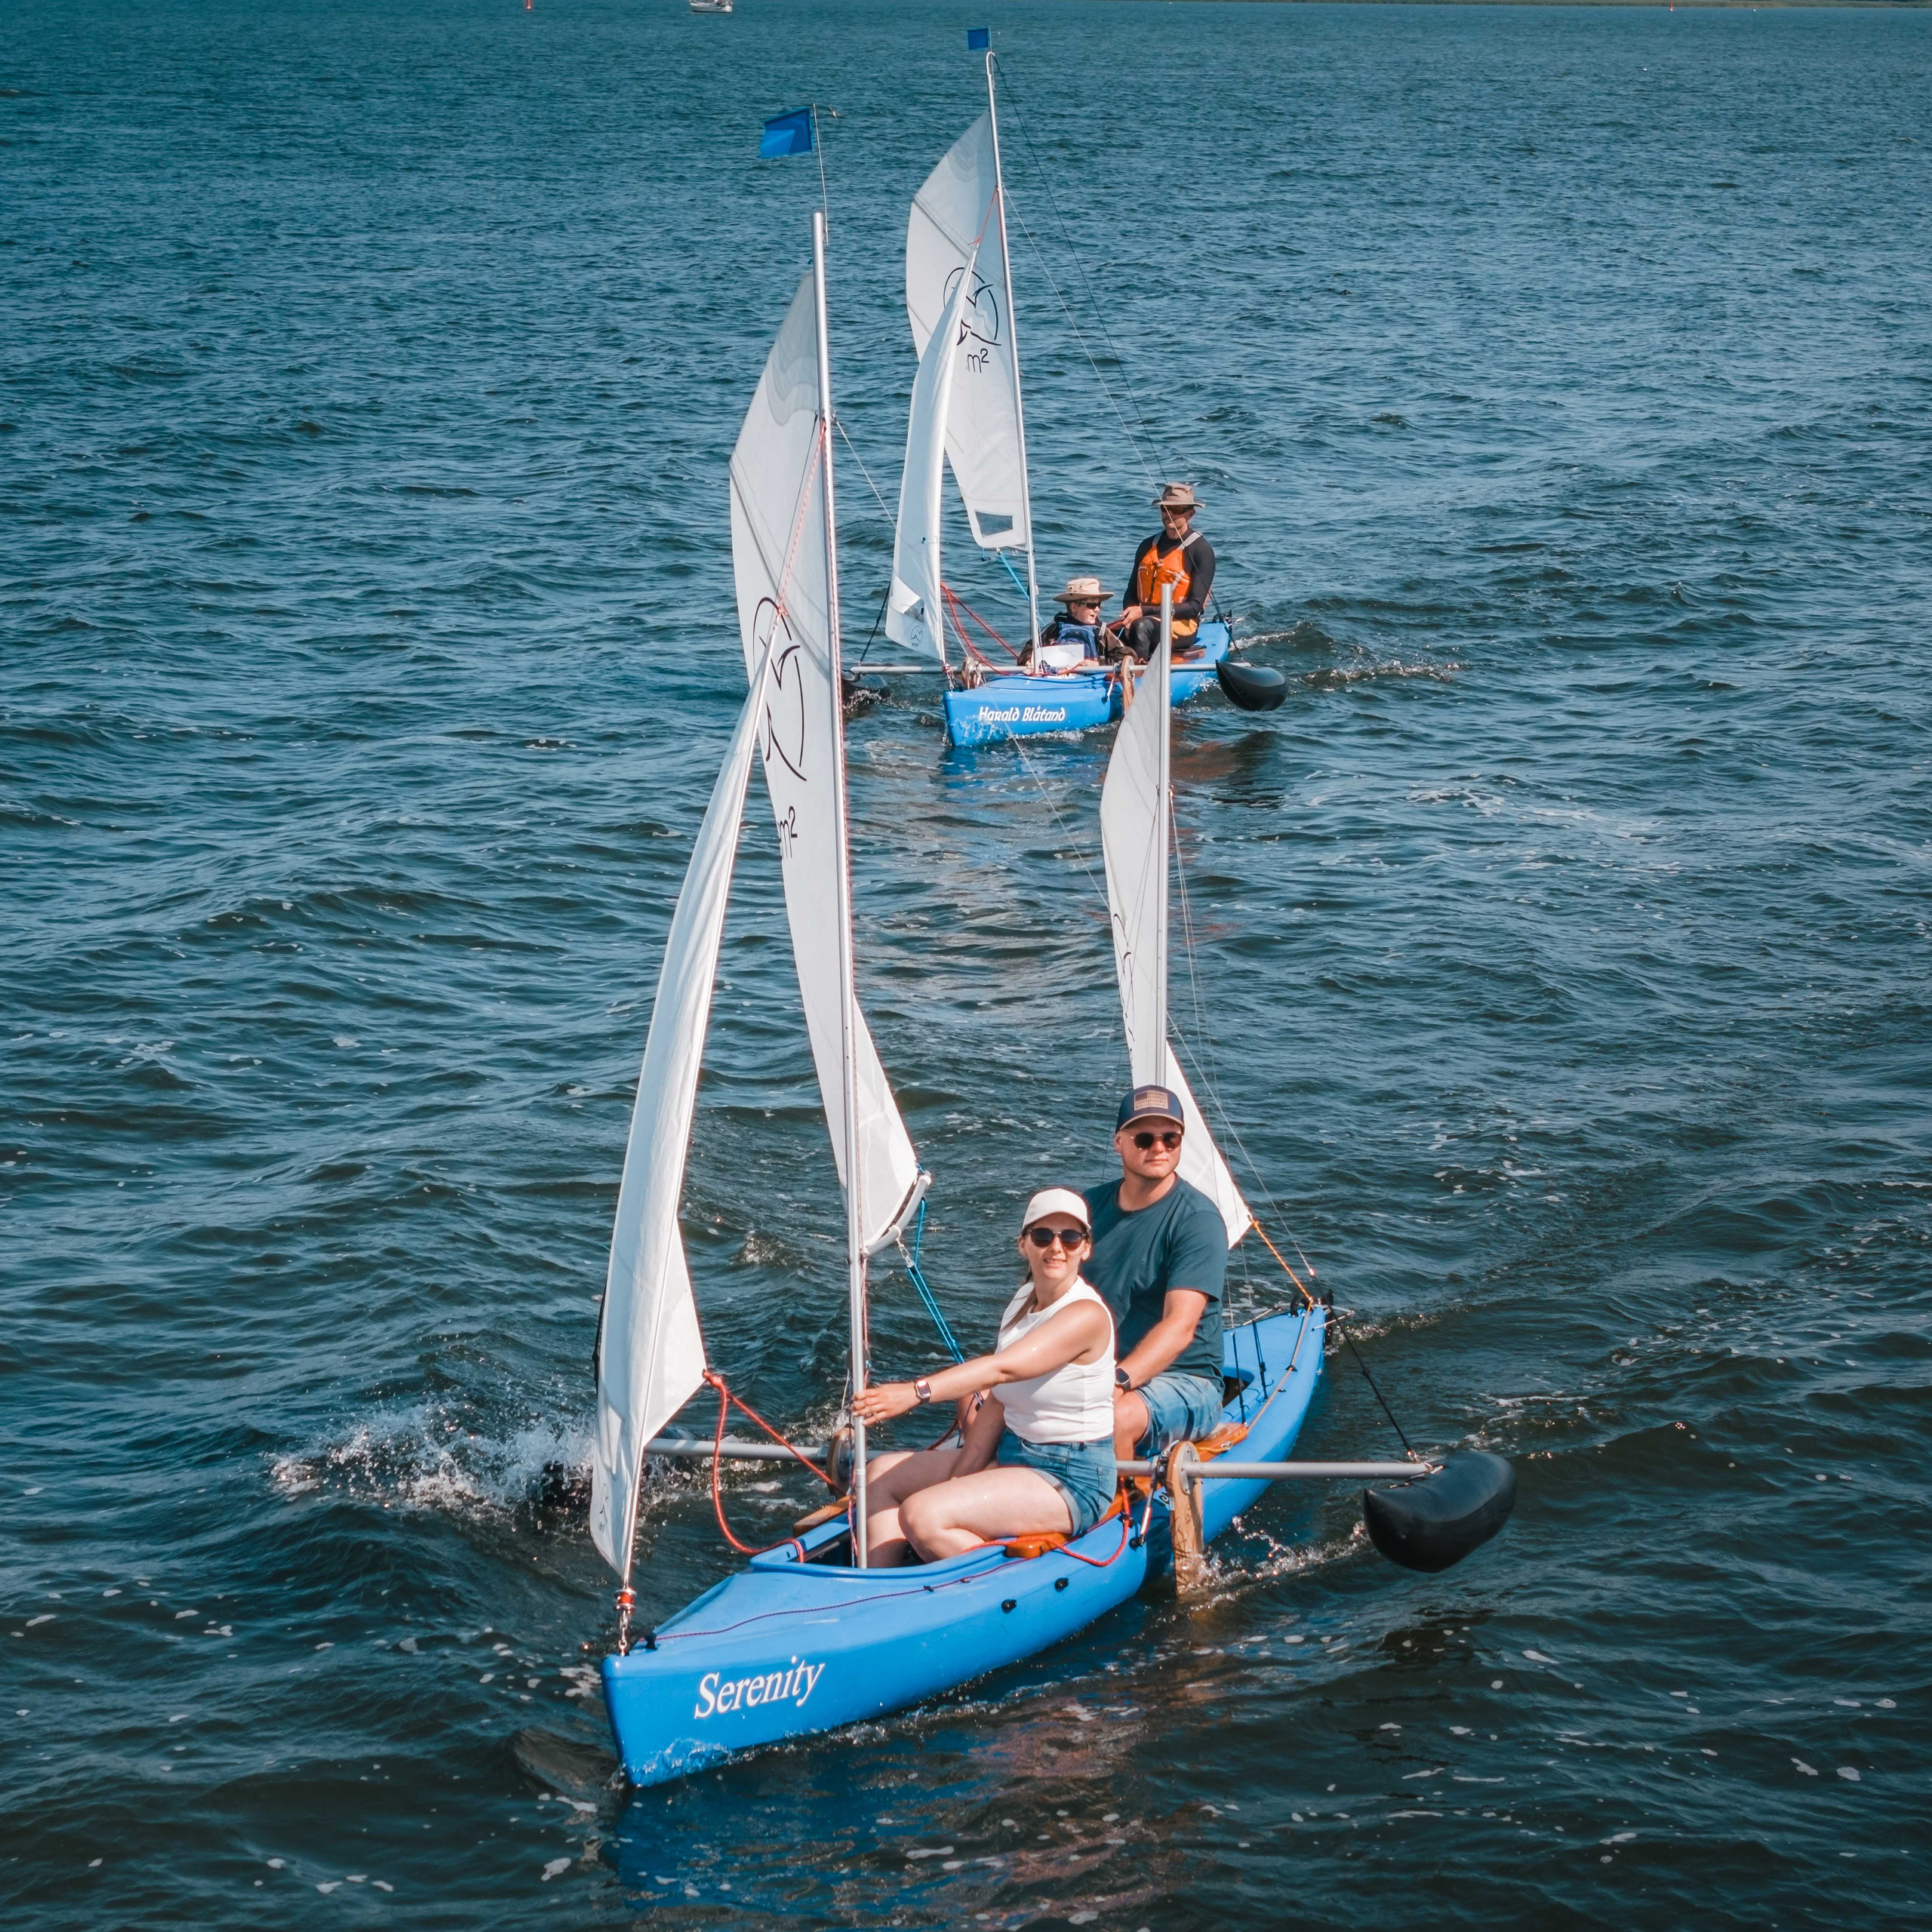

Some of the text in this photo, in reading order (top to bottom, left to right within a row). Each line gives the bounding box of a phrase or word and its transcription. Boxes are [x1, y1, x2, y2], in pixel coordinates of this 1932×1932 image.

[979, 706, 1066, 721] Harald Blåtand
[694, 1655, 826, 1719] Serenity
